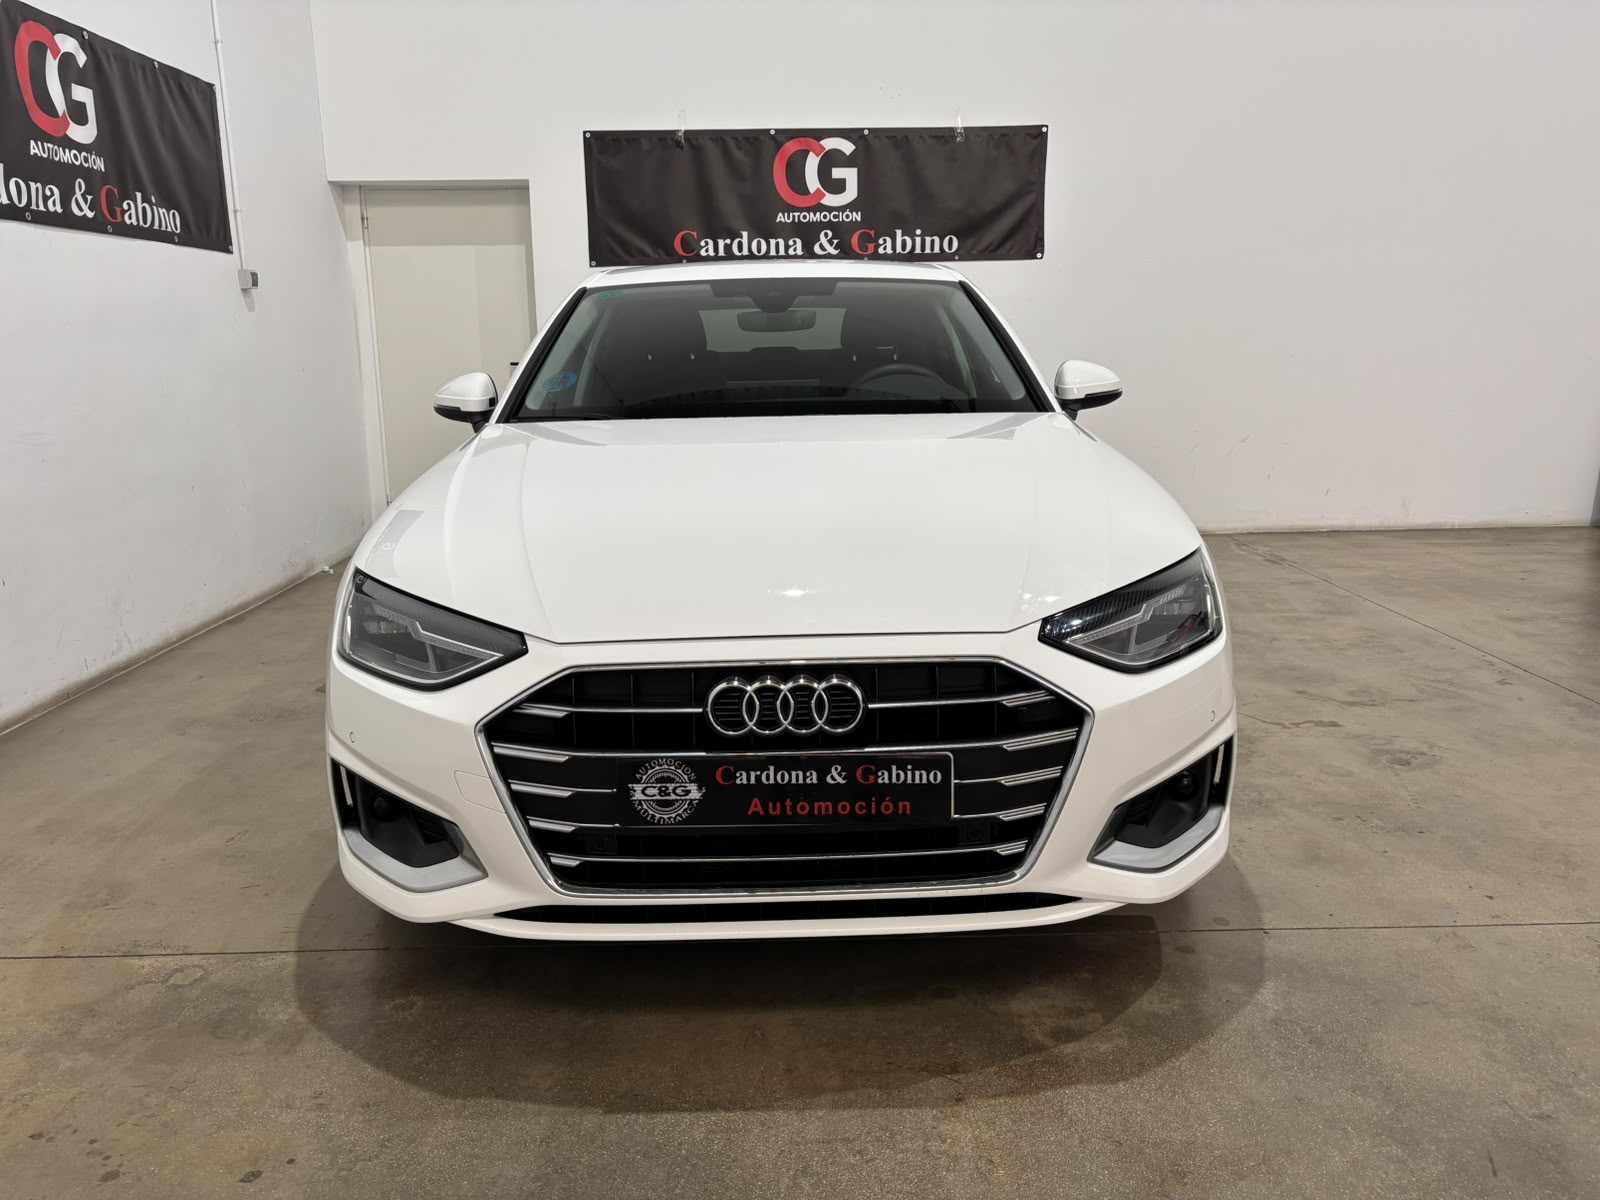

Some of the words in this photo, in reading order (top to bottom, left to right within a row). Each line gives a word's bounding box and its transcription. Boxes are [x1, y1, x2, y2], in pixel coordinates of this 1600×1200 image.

[29, 139, 105, 172] AUTOMOCIÓN
[71, 178, 96, 218] &
[101, 185, 181, 234] Gabino
[776, 209, 861, 223] AUTOMOCIÓN
[673, 229, 804, 257] Cardona
[813, 229, 841, 256] &
[850, 229, 959, 255] Gabino
[715, 764, 818, 785] Cardona
[826, 765, 848, 784] &
[855, 764, 942, 785] Gabino
[641, 785, 692, 798] C&G
[748, 797, 912, 815] Automoción
